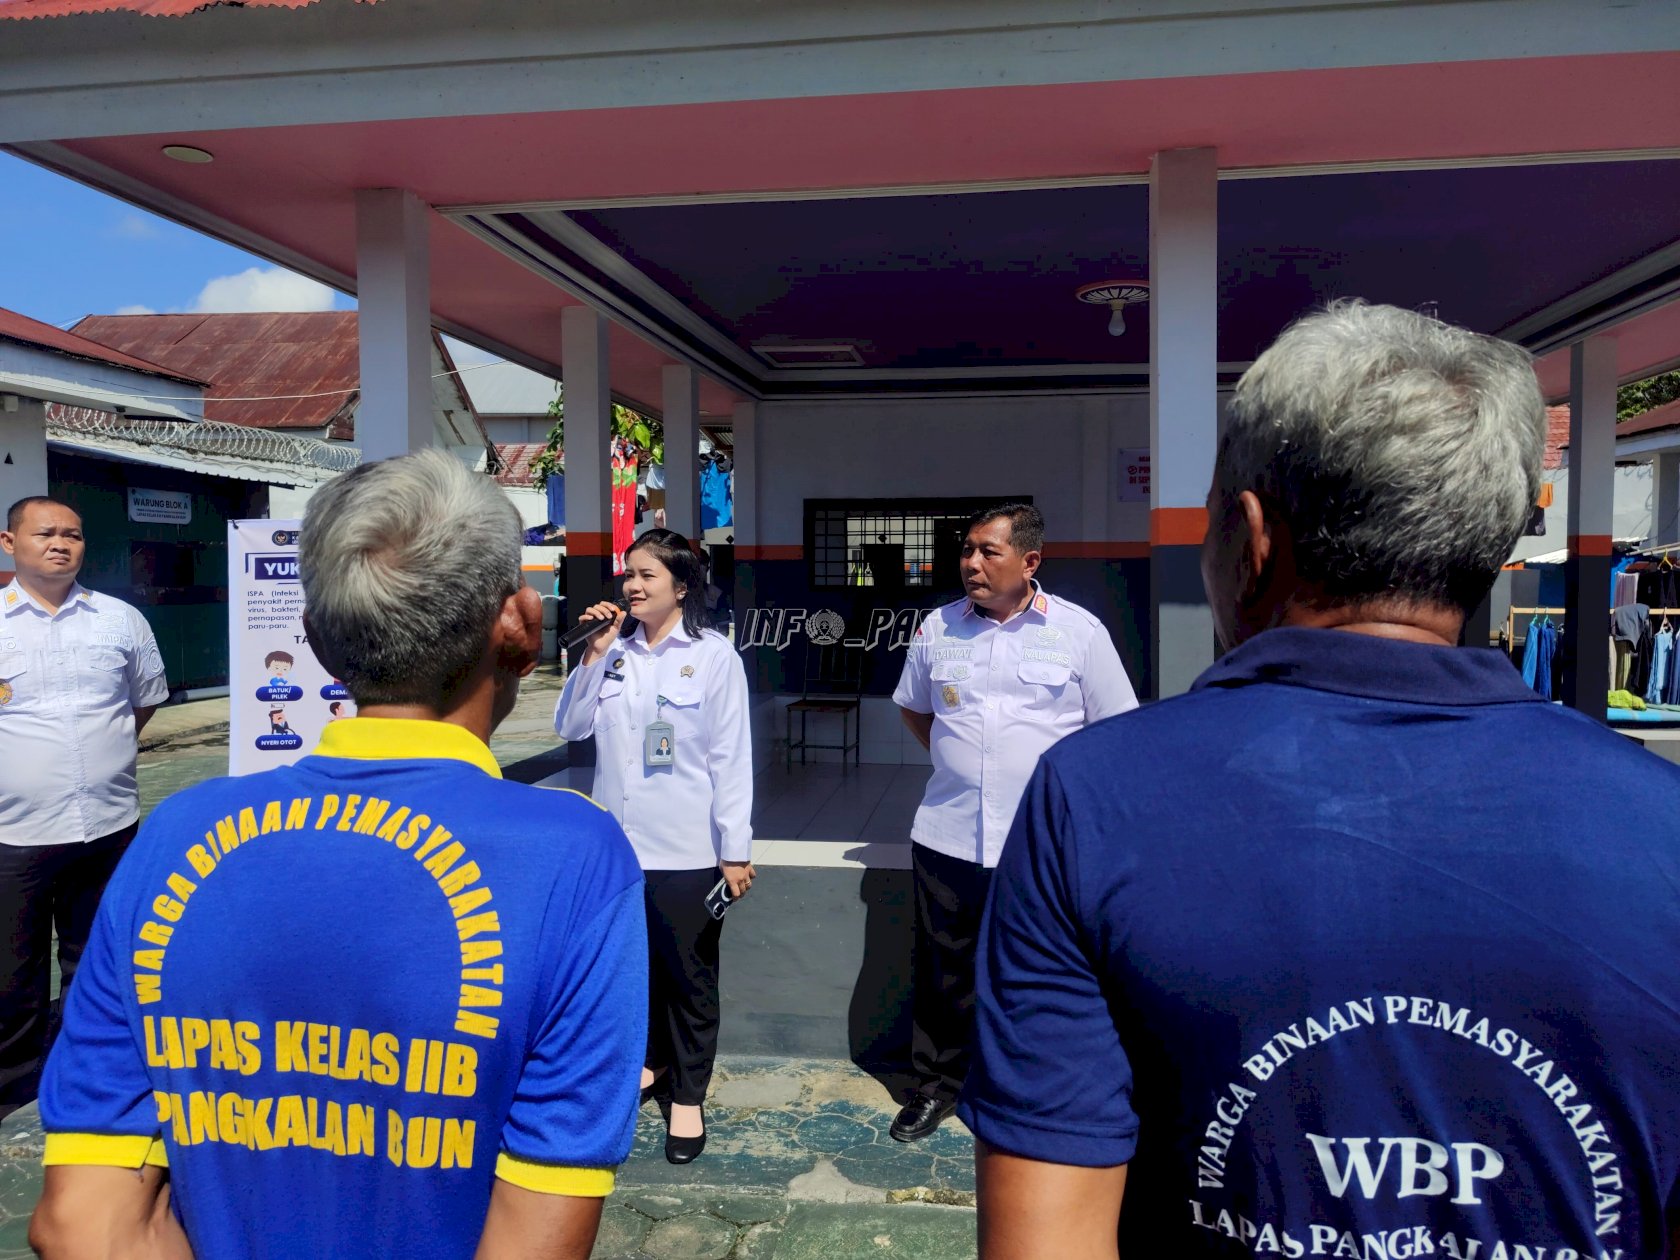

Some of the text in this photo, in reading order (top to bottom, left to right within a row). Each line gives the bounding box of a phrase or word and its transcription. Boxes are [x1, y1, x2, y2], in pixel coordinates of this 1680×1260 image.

[133, 497, 164, 508] WARUNG
[166, 500, 182, 509] BLOK
[133, 793, 504, 1039] WARGA BINAAN PEMASYARAKATAN
[143, 1015, 479, 1098] LAPAS KELAS IIB
[153, 1090, 477, 1170] PANGKALAN BUN
[1196, 994, 1624, 1237] WARGA BINAAN PEMASYARAKATAN
[1305, 1132, 1506, 1206] WBP
[1188, 1199, 1305, 1259] LAPAS
